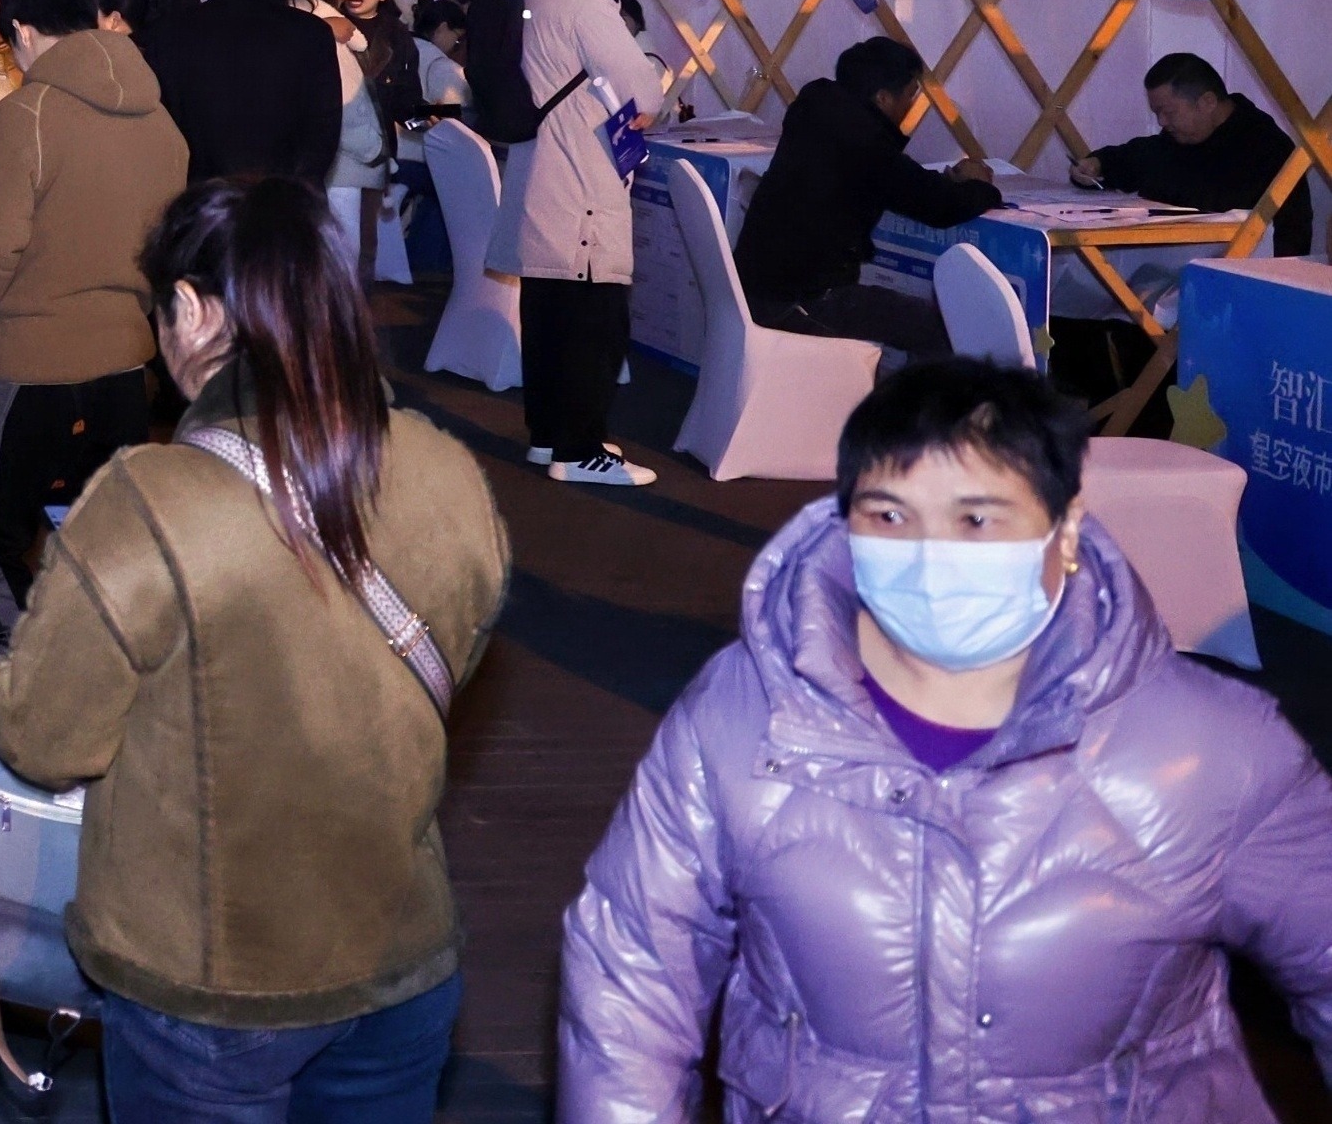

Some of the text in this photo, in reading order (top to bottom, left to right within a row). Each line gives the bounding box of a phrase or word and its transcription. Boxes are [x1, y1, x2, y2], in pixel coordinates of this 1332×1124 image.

[1270, 360, 1332, 433] 智汇
[1250, 427, 1332, 496] 星空夜市
